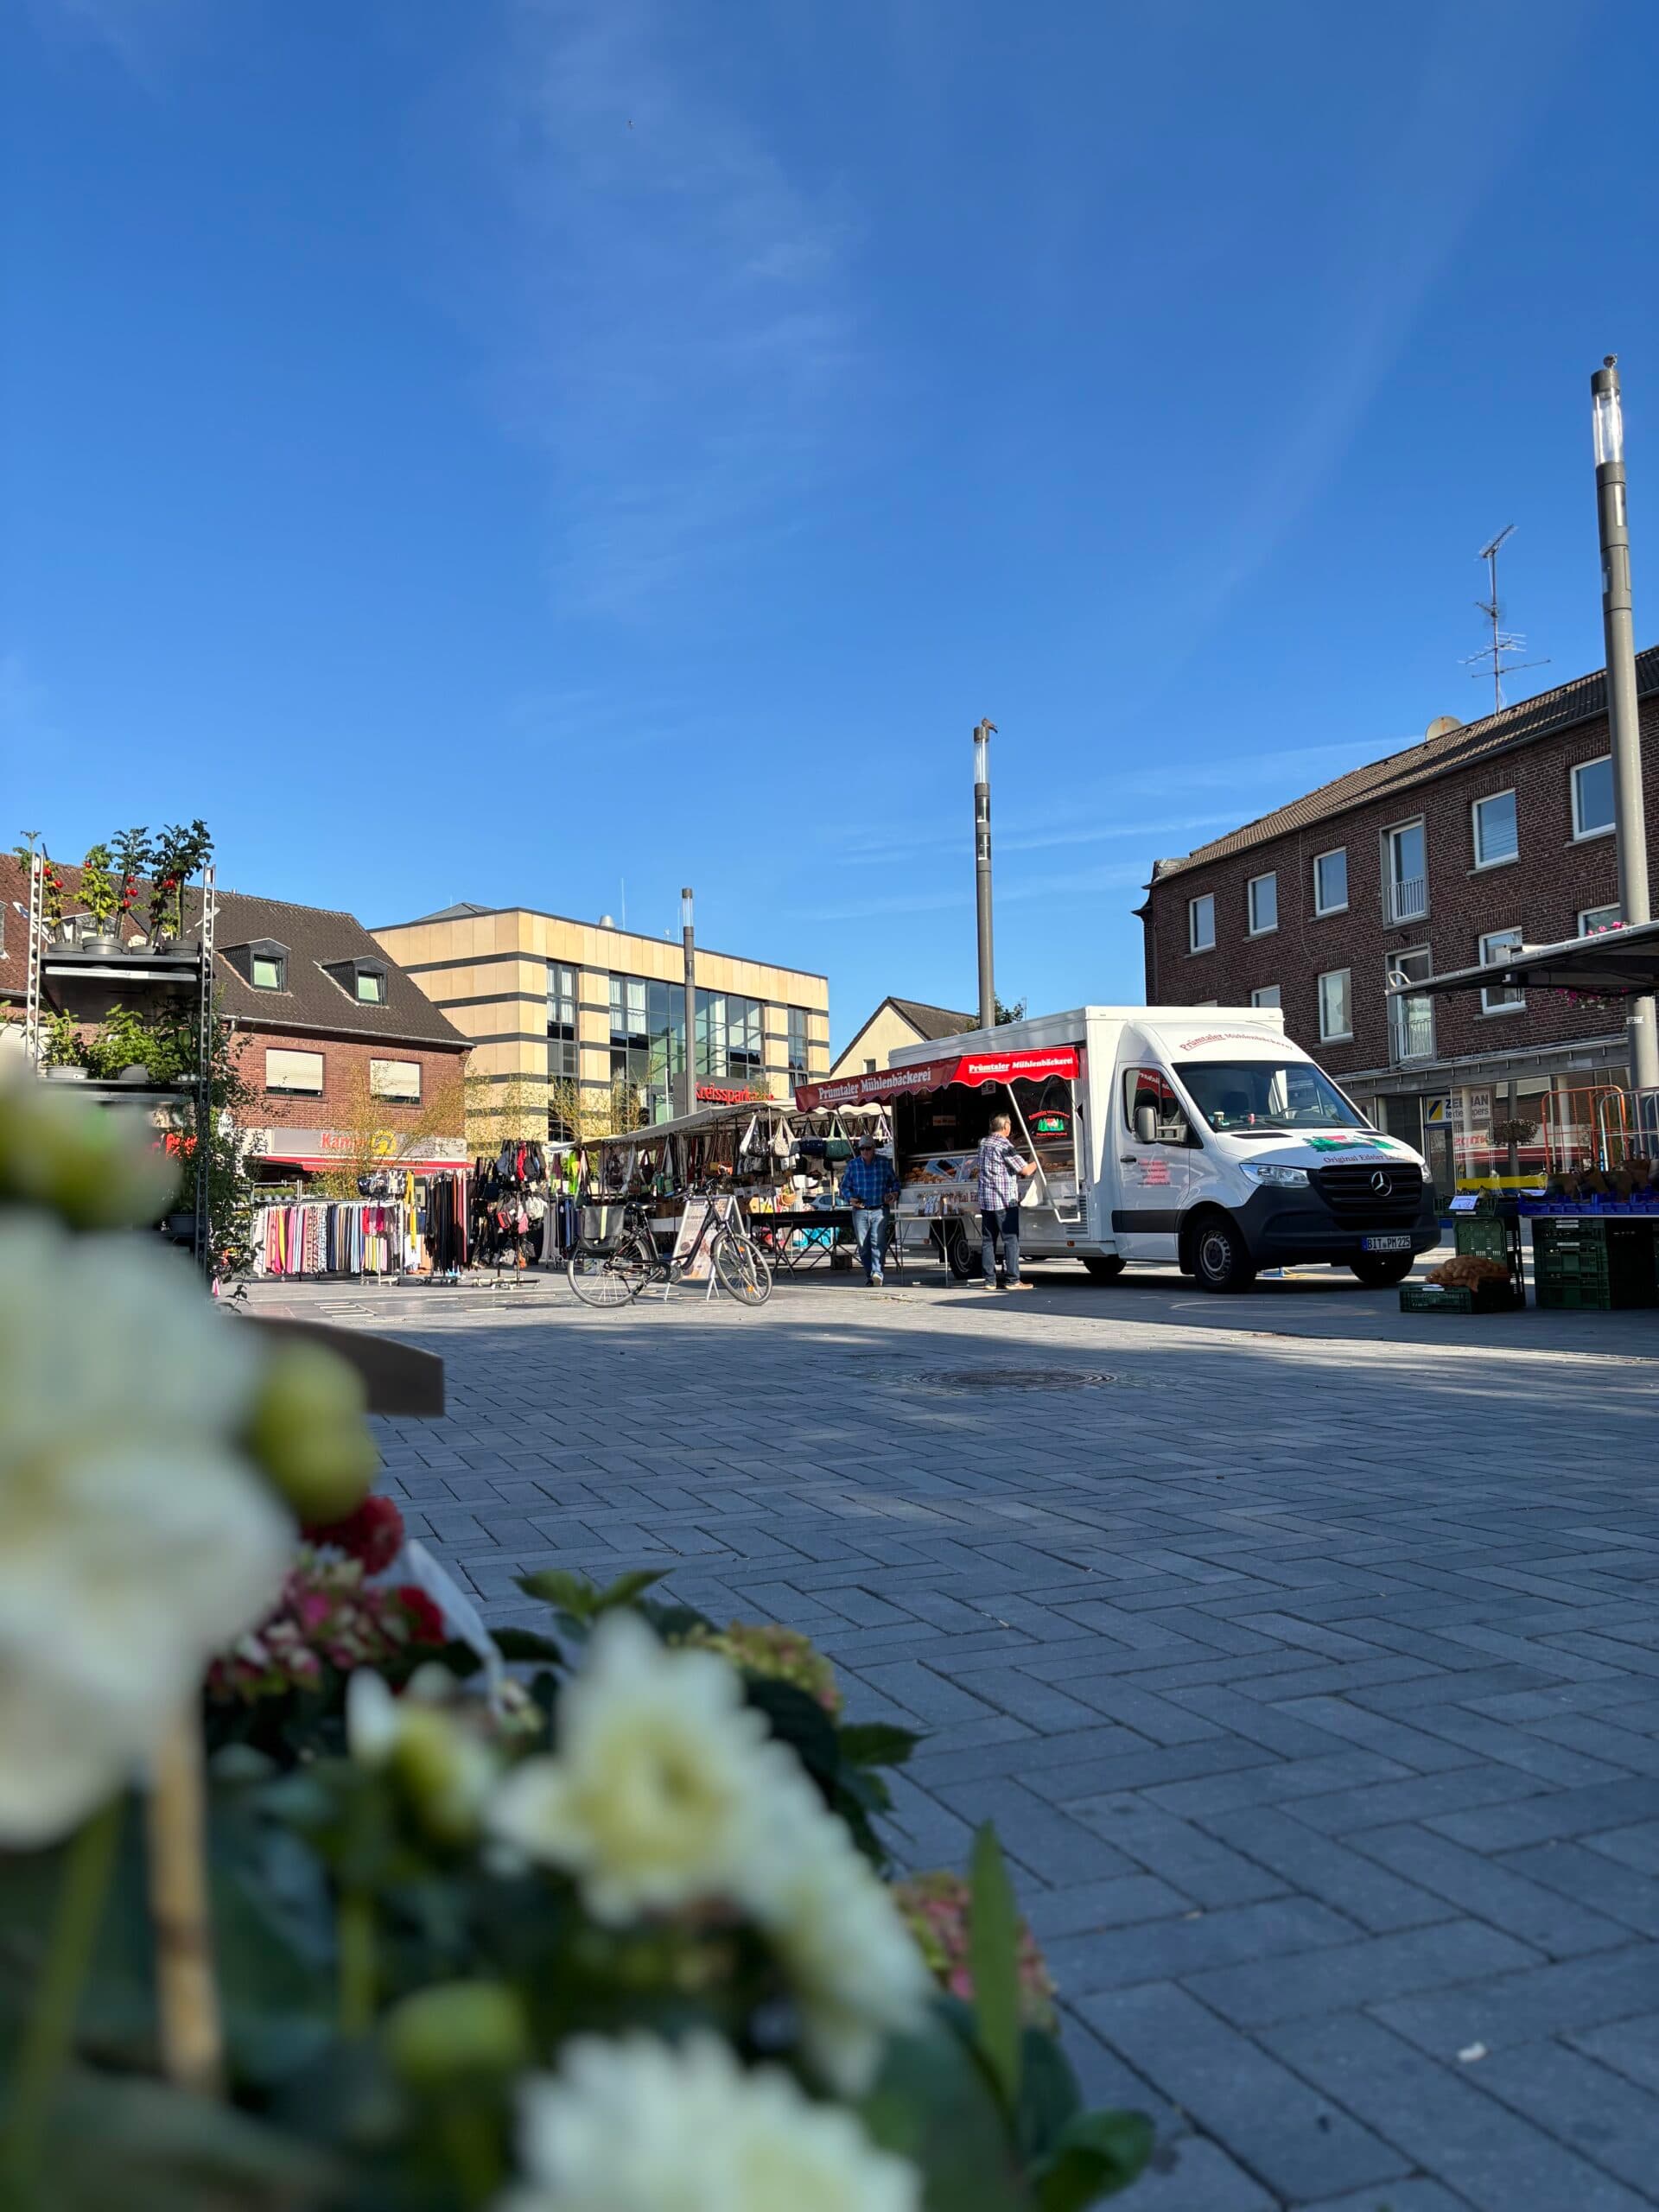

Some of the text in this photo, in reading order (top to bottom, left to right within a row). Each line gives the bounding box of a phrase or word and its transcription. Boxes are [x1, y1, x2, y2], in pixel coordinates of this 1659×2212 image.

[969, 1057, 1073, 1072] Prümtaler Mühlenbäckerei
[817, 1067, 931, 1101] Prümtaler Mühlenbäckerei
[1446, 1094, 1488, 1109] ZEEAN
[1323, 1155, 1358, 1164] Original
[1367, 1238, 1382, 1249] BIT
